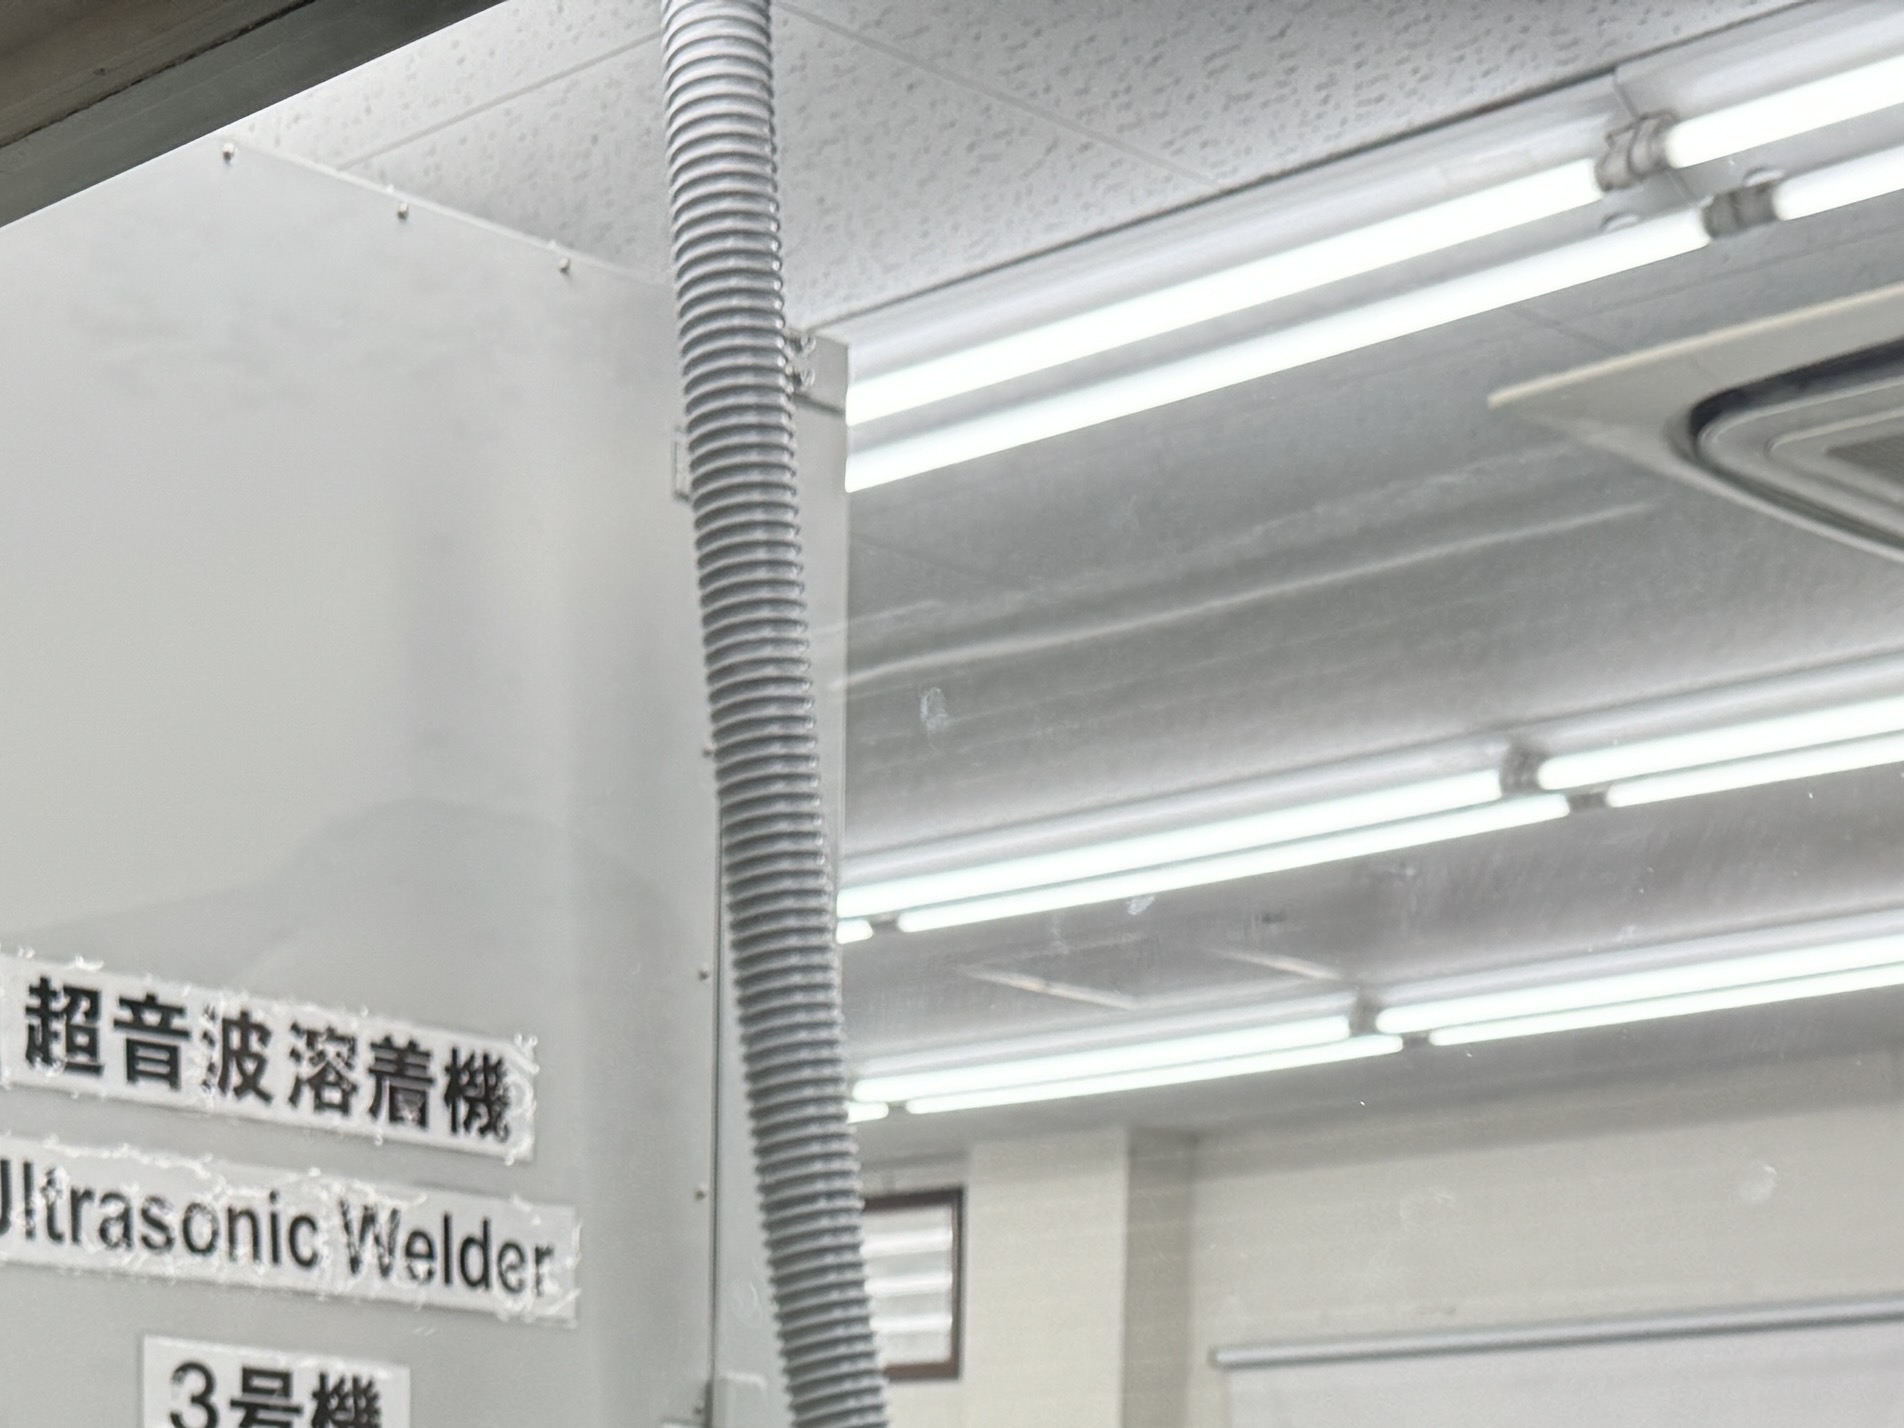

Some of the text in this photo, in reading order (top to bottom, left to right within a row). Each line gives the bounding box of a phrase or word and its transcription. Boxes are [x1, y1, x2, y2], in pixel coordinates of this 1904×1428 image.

[24, 976, 512, 1142] 超音波溶着機
[338, 1198, 554, 1297] Welder
